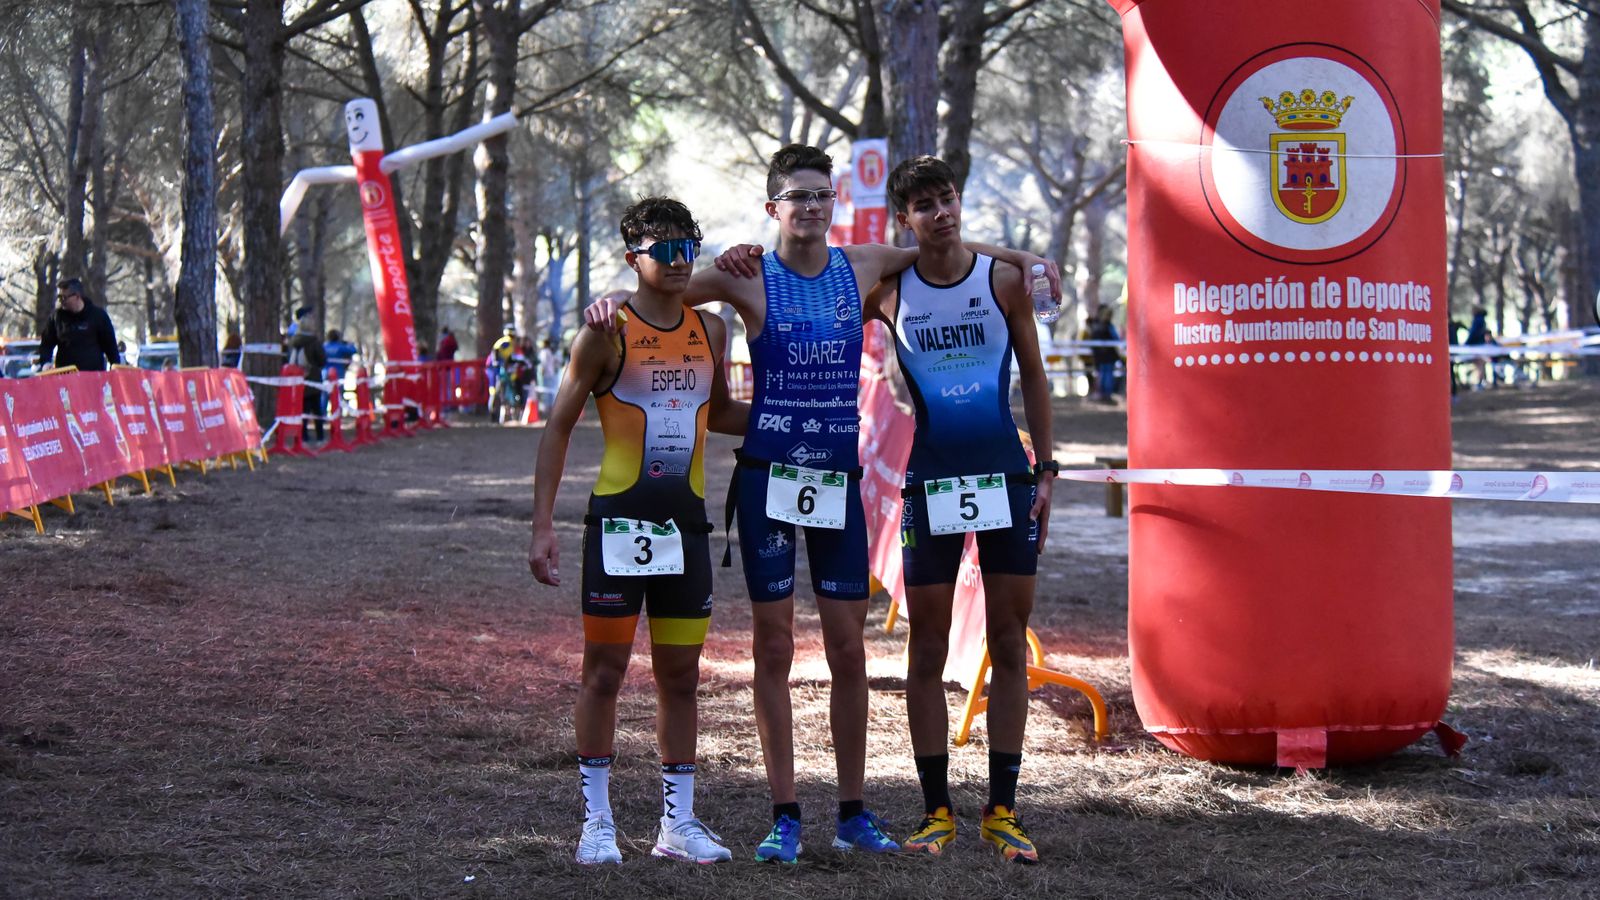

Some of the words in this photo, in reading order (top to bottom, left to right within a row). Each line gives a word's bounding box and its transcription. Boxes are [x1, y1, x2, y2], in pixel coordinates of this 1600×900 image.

[1174, 276, 1305, 315] Delegación
[1311, 276, 1341, 309] de
[1347, 276, 1431, 312] Deportes
[915, 322, 986, 353] VALENTIN
[1174, 322, 1221, 345] Ilustre
[1224, 317, 1342, 344] Ayuntamiento
[1346, 317, 1366, 340] de
[1368, 317, 1396, 341] San
[1398, 319, 1431, 344] Roque
[788, 340, 847, 365] SUAREZ
[651, 368, 696, 392] ESPEJO
[797, 485, 817, 515] 6
[959, 492, 979, 521] 5
[634, 535, 653, 566] 3
